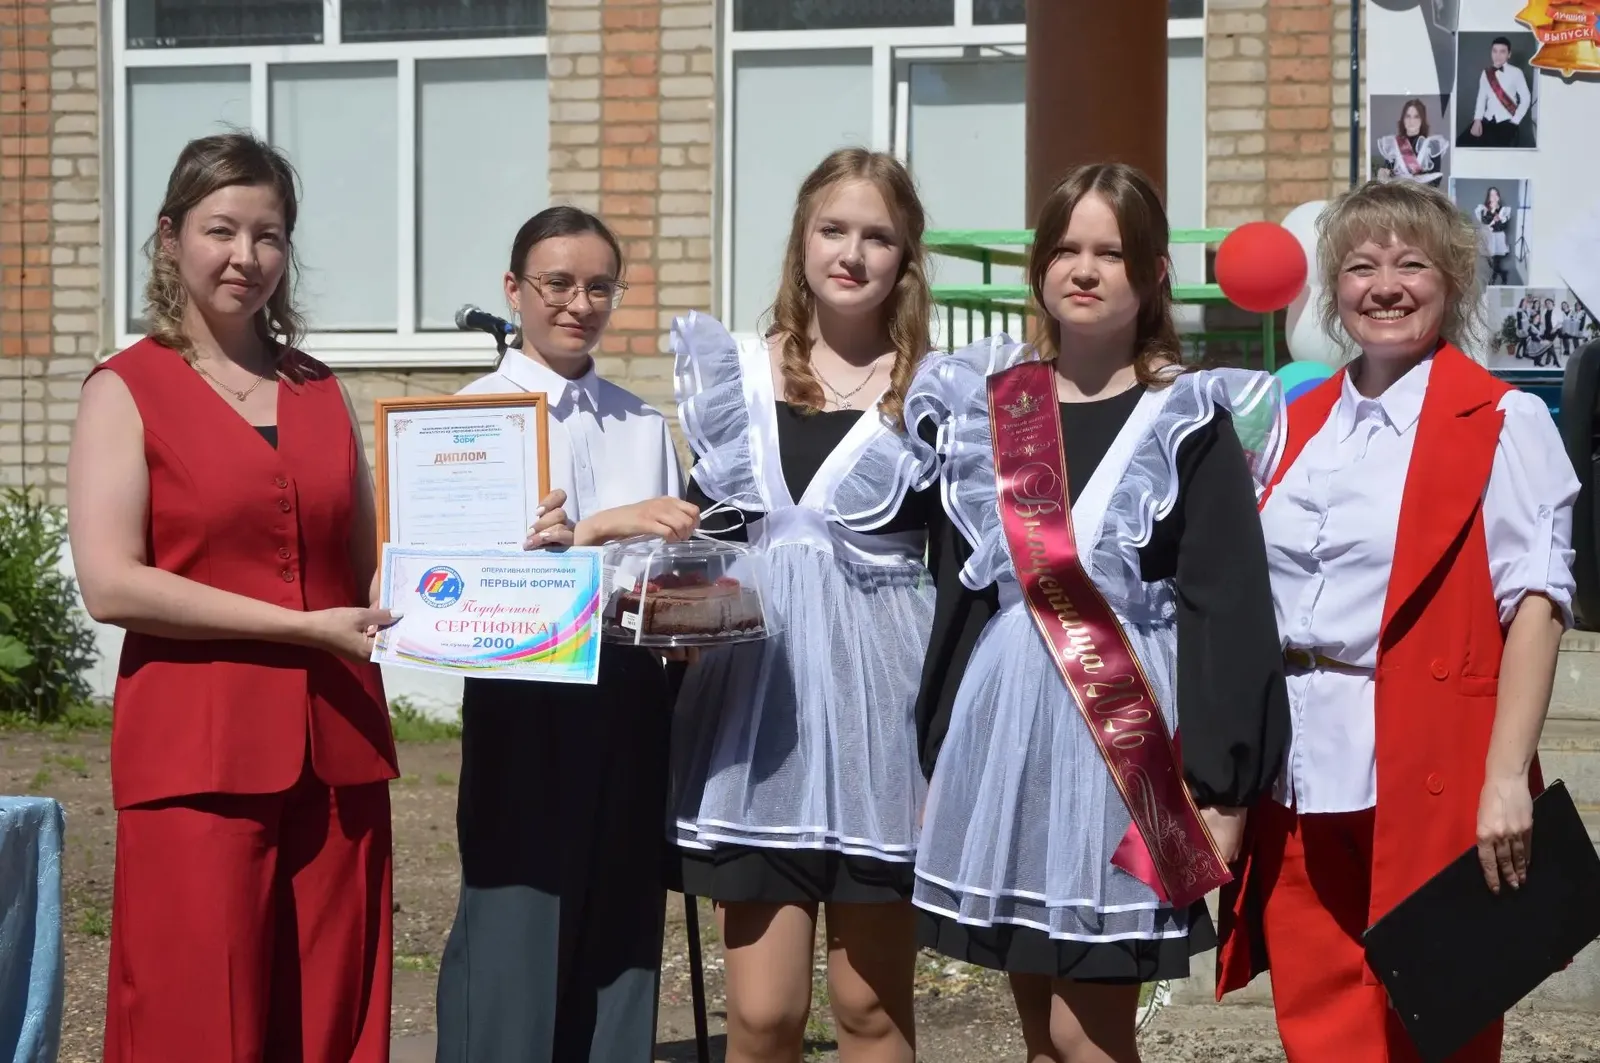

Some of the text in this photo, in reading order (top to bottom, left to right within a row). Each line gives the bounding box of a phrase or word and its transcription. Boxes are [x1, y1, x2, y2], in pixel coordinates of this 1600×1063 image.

[1553, 11, 1587, 22] ЛУЧШИЙ
[1544, 29, 1594, 42] ВЫПУСК!
[434, 451, 487, 465] ДИПЛОМ
[480, 577, 576, 589] ПЕРВЫЙ ФОРМАТ
[460, 600, 541, 619] Подарочный
[1011, 461, 1105, 675] Выпускница
[1083, 674, 1159, 749] 2026
[435, 620, 560, 635] СЕРТИФИКАТ
[472, 637, 515, 650] 2000
